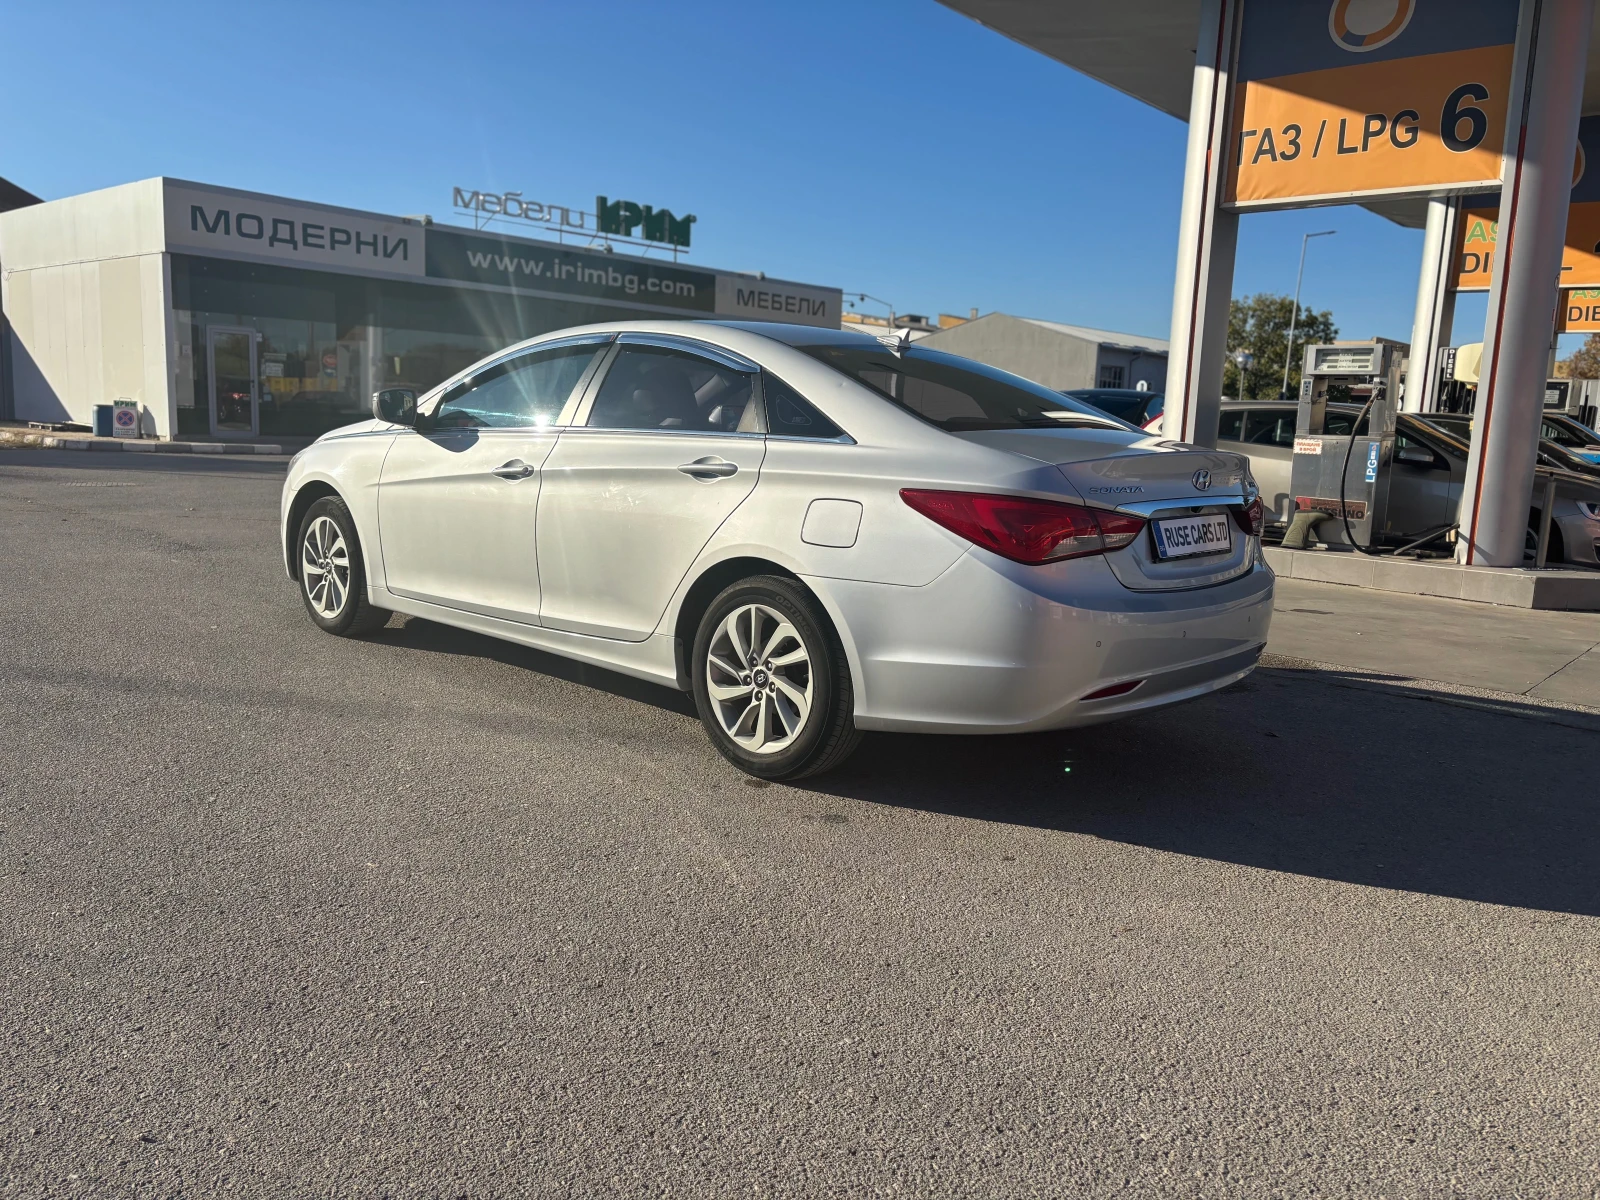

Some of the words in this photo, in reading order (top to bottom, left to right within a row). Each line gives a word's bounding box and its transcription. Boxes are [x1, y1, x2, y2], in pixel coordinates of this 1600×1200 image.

[1237, 124, 1302, 166] ГАЗ
[1312, 119, 1327, 158] /
[1336, 109, 1420, 155] LPG
[1440, 82, 1490, 152] 6
[453, 187, 584, 229] Мебели
[190, 205, 408, 261] МОДЕРНИ
[467, 250, 695, 298] www.irimbg.com
[736, 287, 826, 318] МЕБЕЛИ
[1446, 349, 1456, 379] DIESEL
[1365, 459, 1378, 482] LPG
[1088, 485, 1145, 494] SONATA
[1164, 525, 1192, 548] RUSE
[1190, 522, 1215, 545] CARS
[1213, 521, 1227, 542] LTD
[775, 595, 812, 635] OPTIMO
